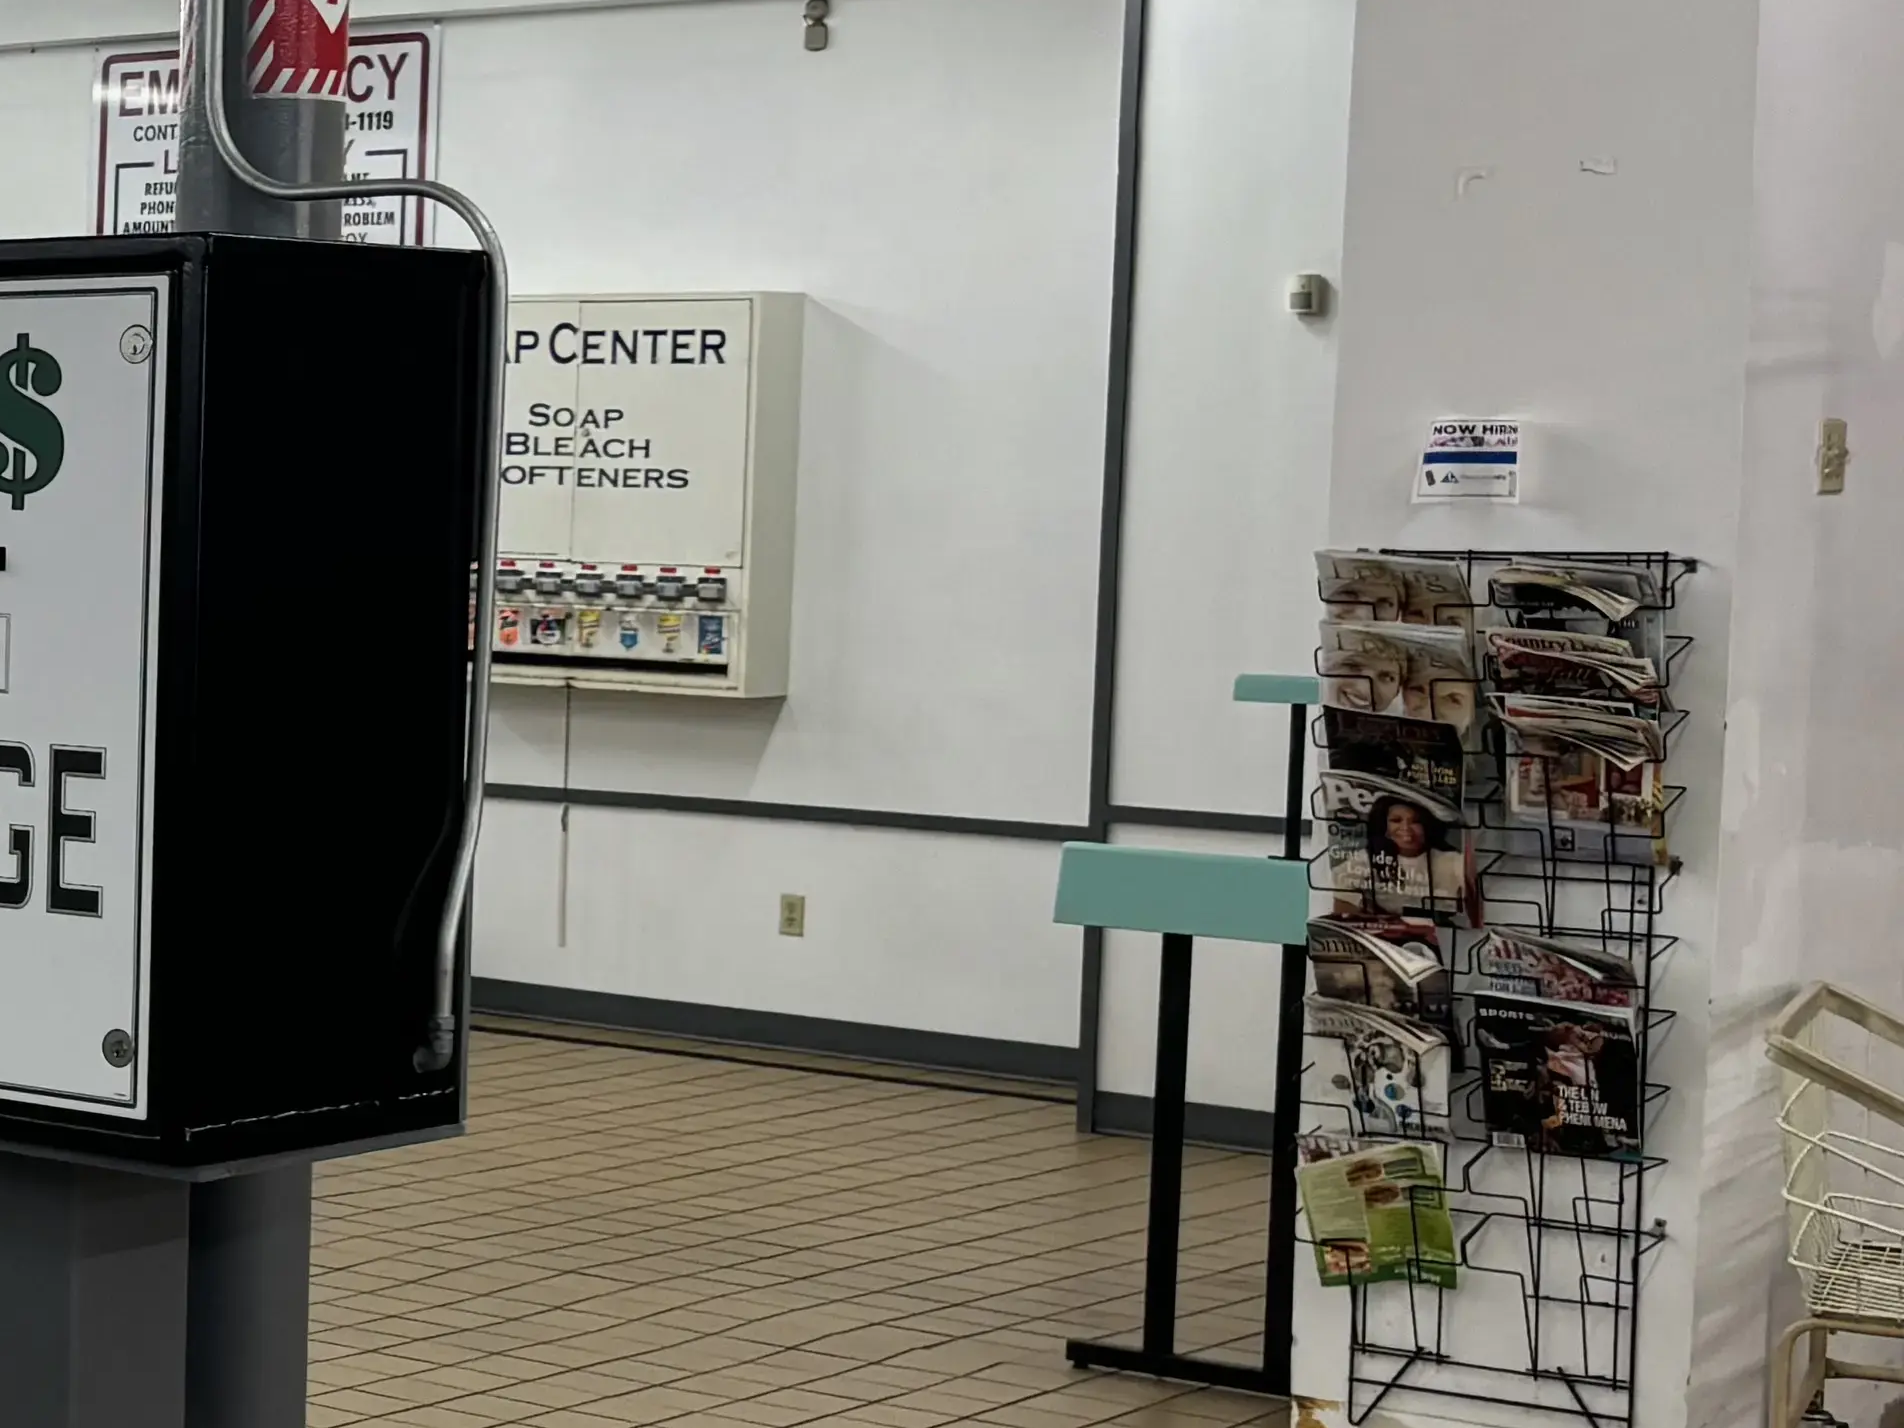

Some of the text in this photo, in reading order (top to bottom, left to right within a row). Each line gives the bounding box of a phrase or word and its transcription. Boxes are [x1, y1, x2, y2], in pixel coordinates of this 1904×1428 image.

[344, 110, 394, 132] -1119
[133, 123, 177, 142] CONT
[144, 181, 177, 197] REFU
[140, 200, 176, 216] PHON
[343, 211, 395, 228] ROBLEM
[549, 322, 727, 365] CENTER
[528, 403, 624, 429] SOAP
[1432, 424, 1477, 436] NOW
[505, 432, 651, 459] BLEACH
[501, 465, 690, 489] OFTENERS
[1558, 1085, 1600, 1102] THE LN
[1559, 1112, 1628, 1131] PHENMENA
